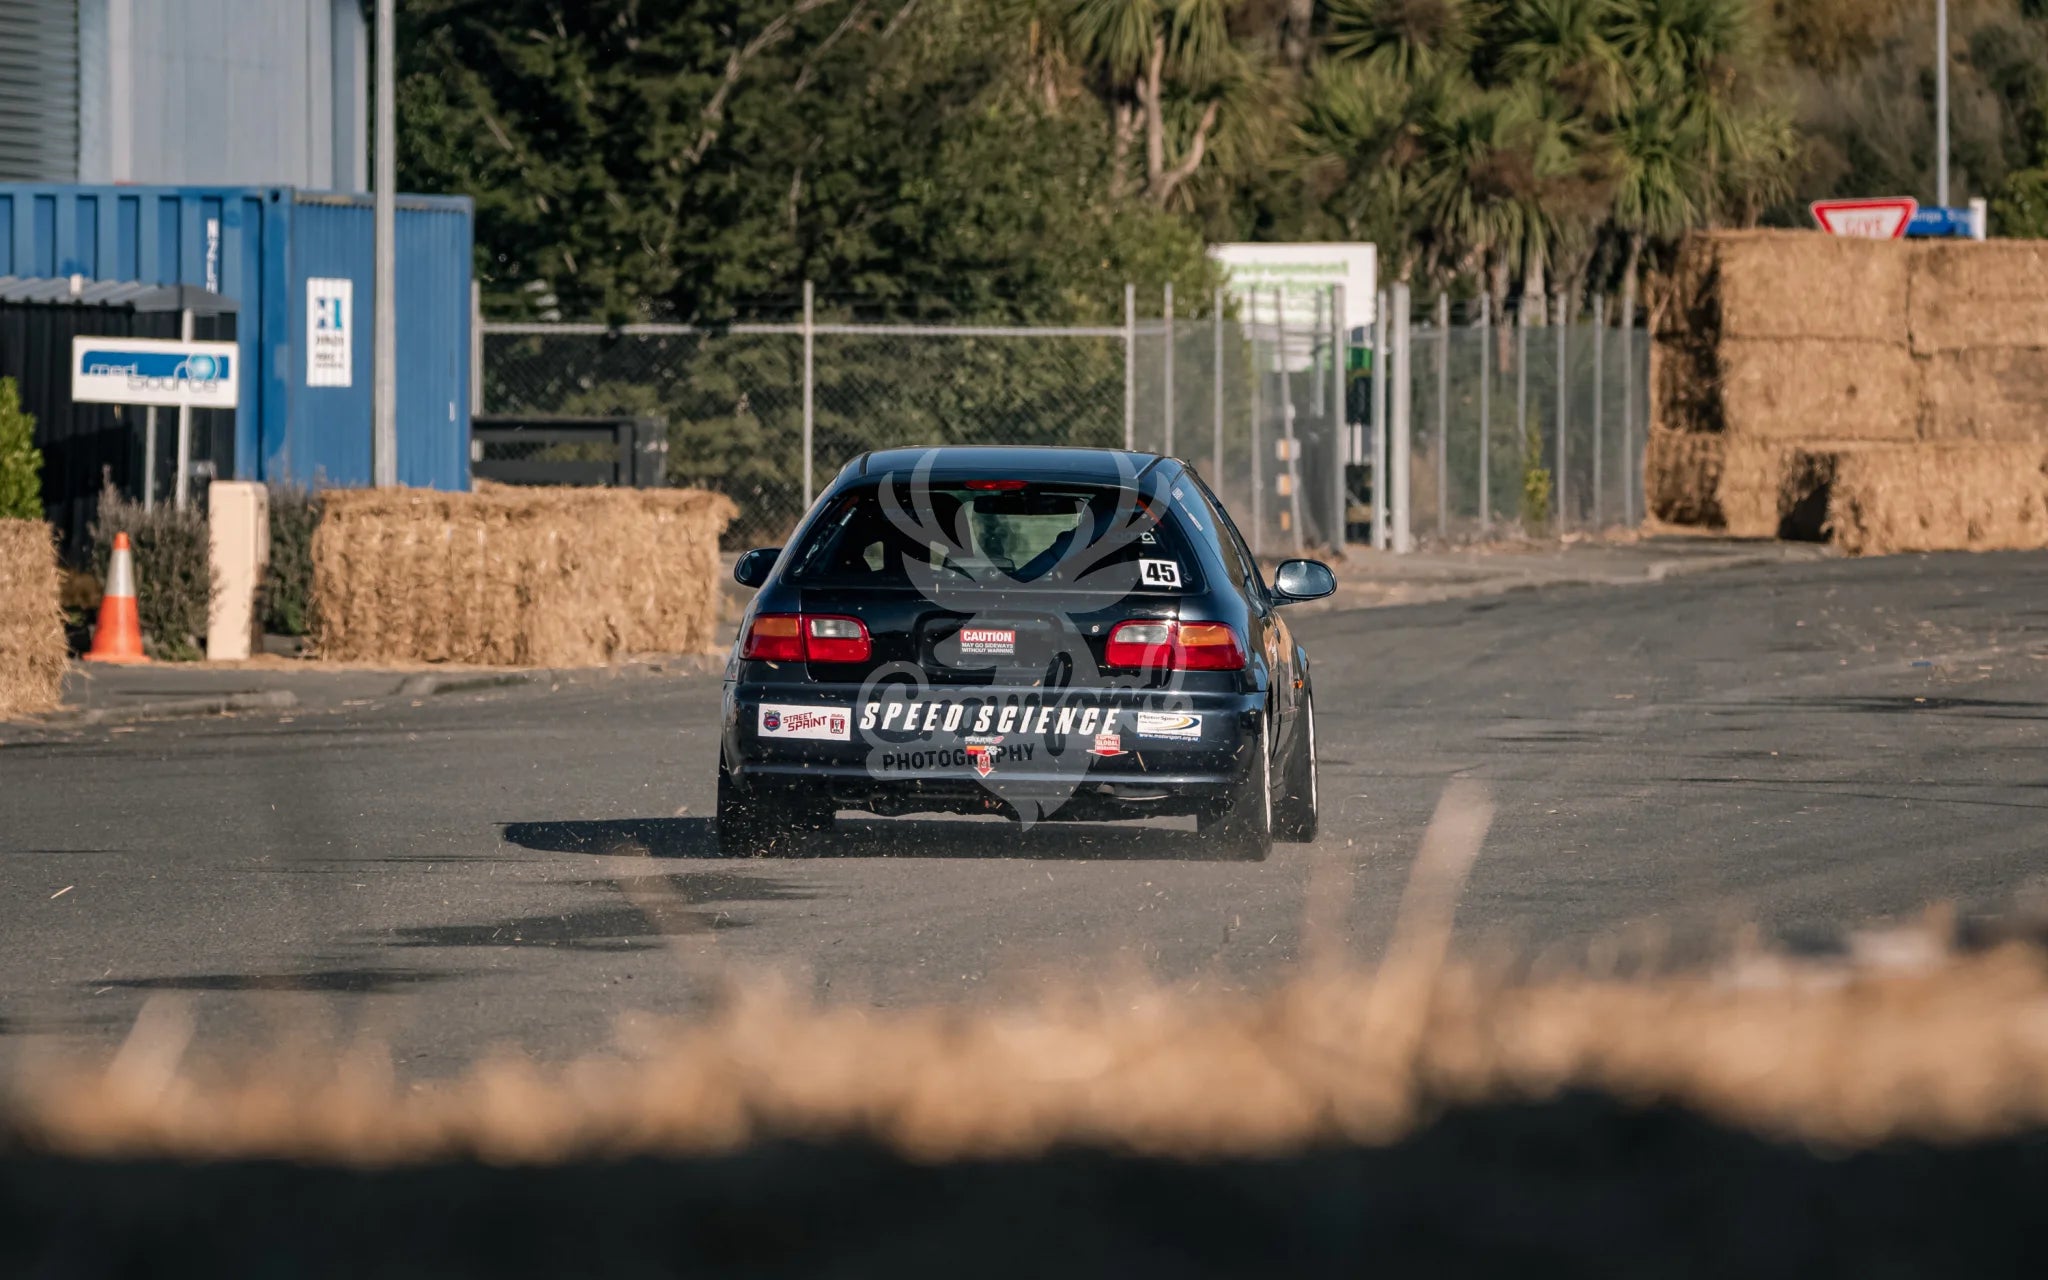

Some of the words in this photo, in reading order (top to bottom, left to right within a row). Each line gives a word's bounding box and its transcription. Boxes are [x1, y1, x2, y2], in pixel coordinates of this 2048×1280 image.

[1843, 214, 1884, 237] GIVE
[1146, 562, 1176, 583] 45
[963, 631, 1012, 642] CAUTION
[783, 711, 813, 724] STREET
[787, 716, 828, 732] SPRINT
[858, 702, 964, 731] SPEED
[973, 705, 1121, 735] SCIENCE
